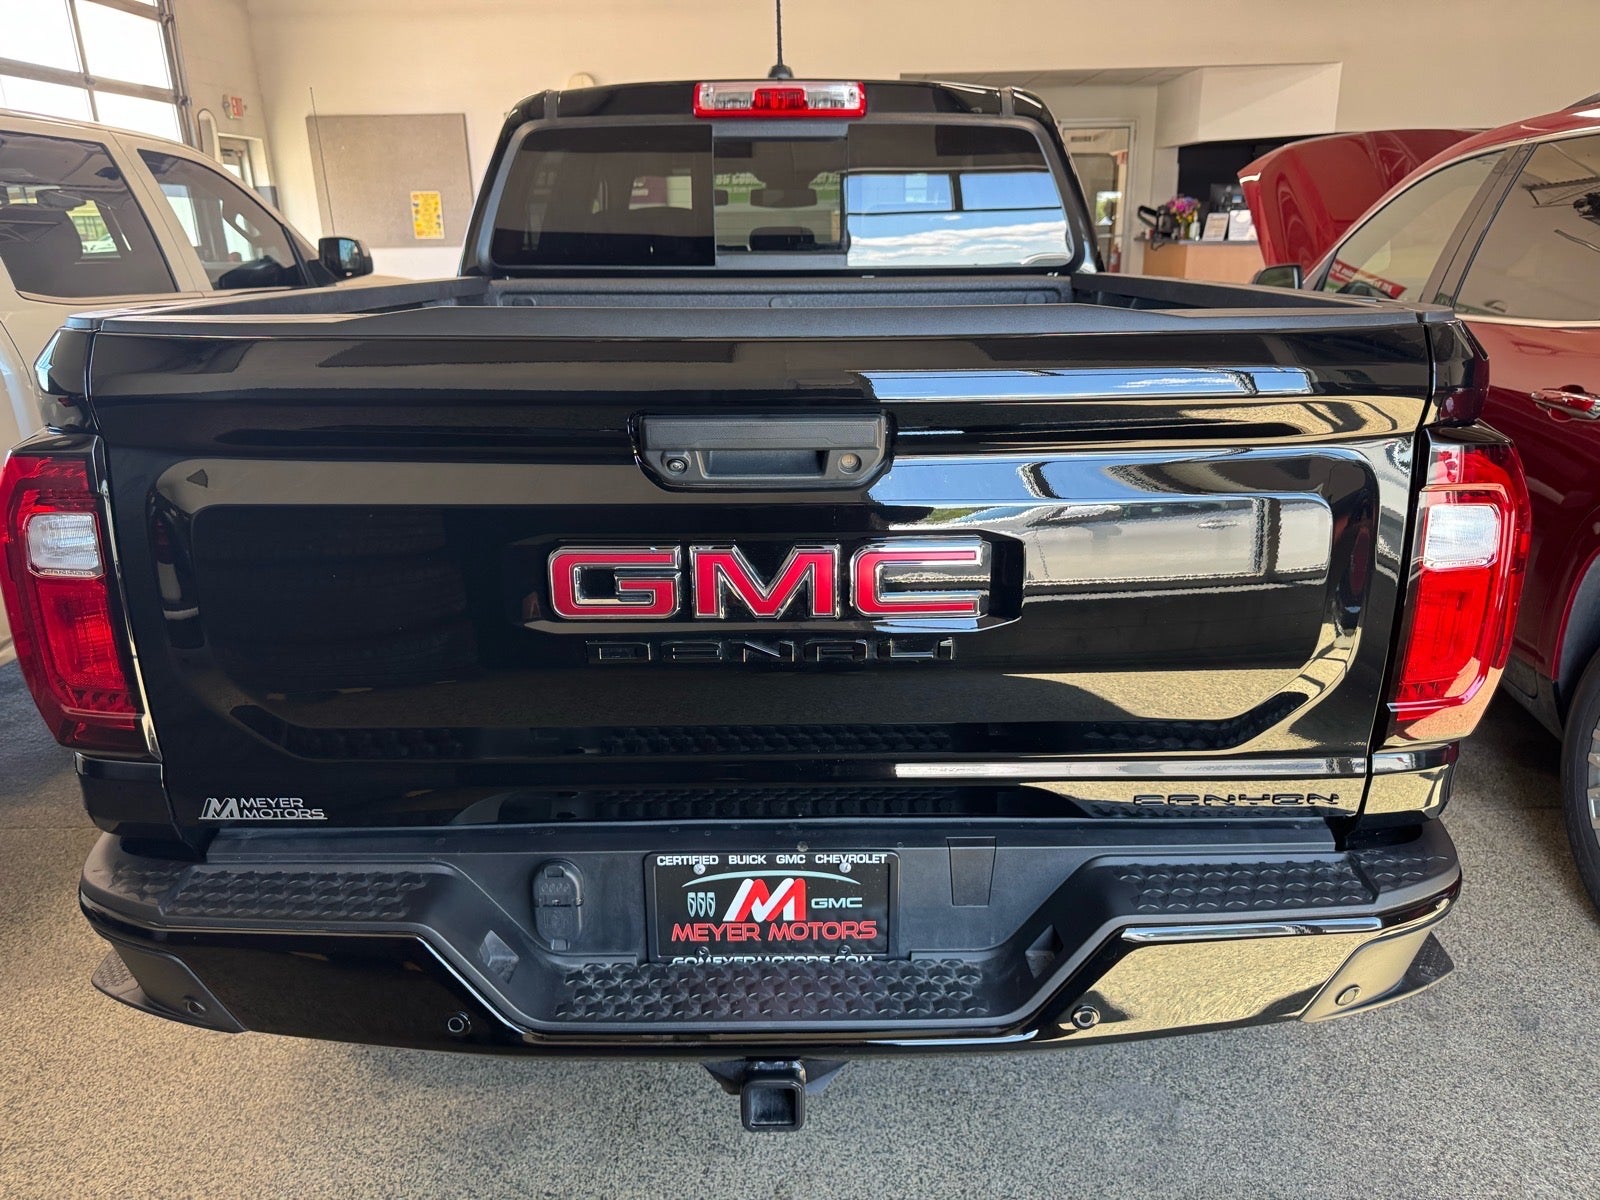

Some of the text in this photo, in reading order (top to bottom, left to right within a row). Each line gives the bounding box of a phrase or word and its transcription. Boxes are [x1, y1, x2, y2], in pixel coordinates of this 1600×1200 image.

[547, 542, 988, 619] GMC
[586, 638, 955, 662] DENALI
[240, 798, 304, 808] MEYER
[1133, 793, 1339, 806] CANYON
[243, 808, 325, 819] MOTORS
[656, 854, 887, 866] CERTIFIED BUICK GMC CHEVROLET
[811, 897, 863, 909] GMC
[671, 921, 877, 942] MEYER MOTORS
